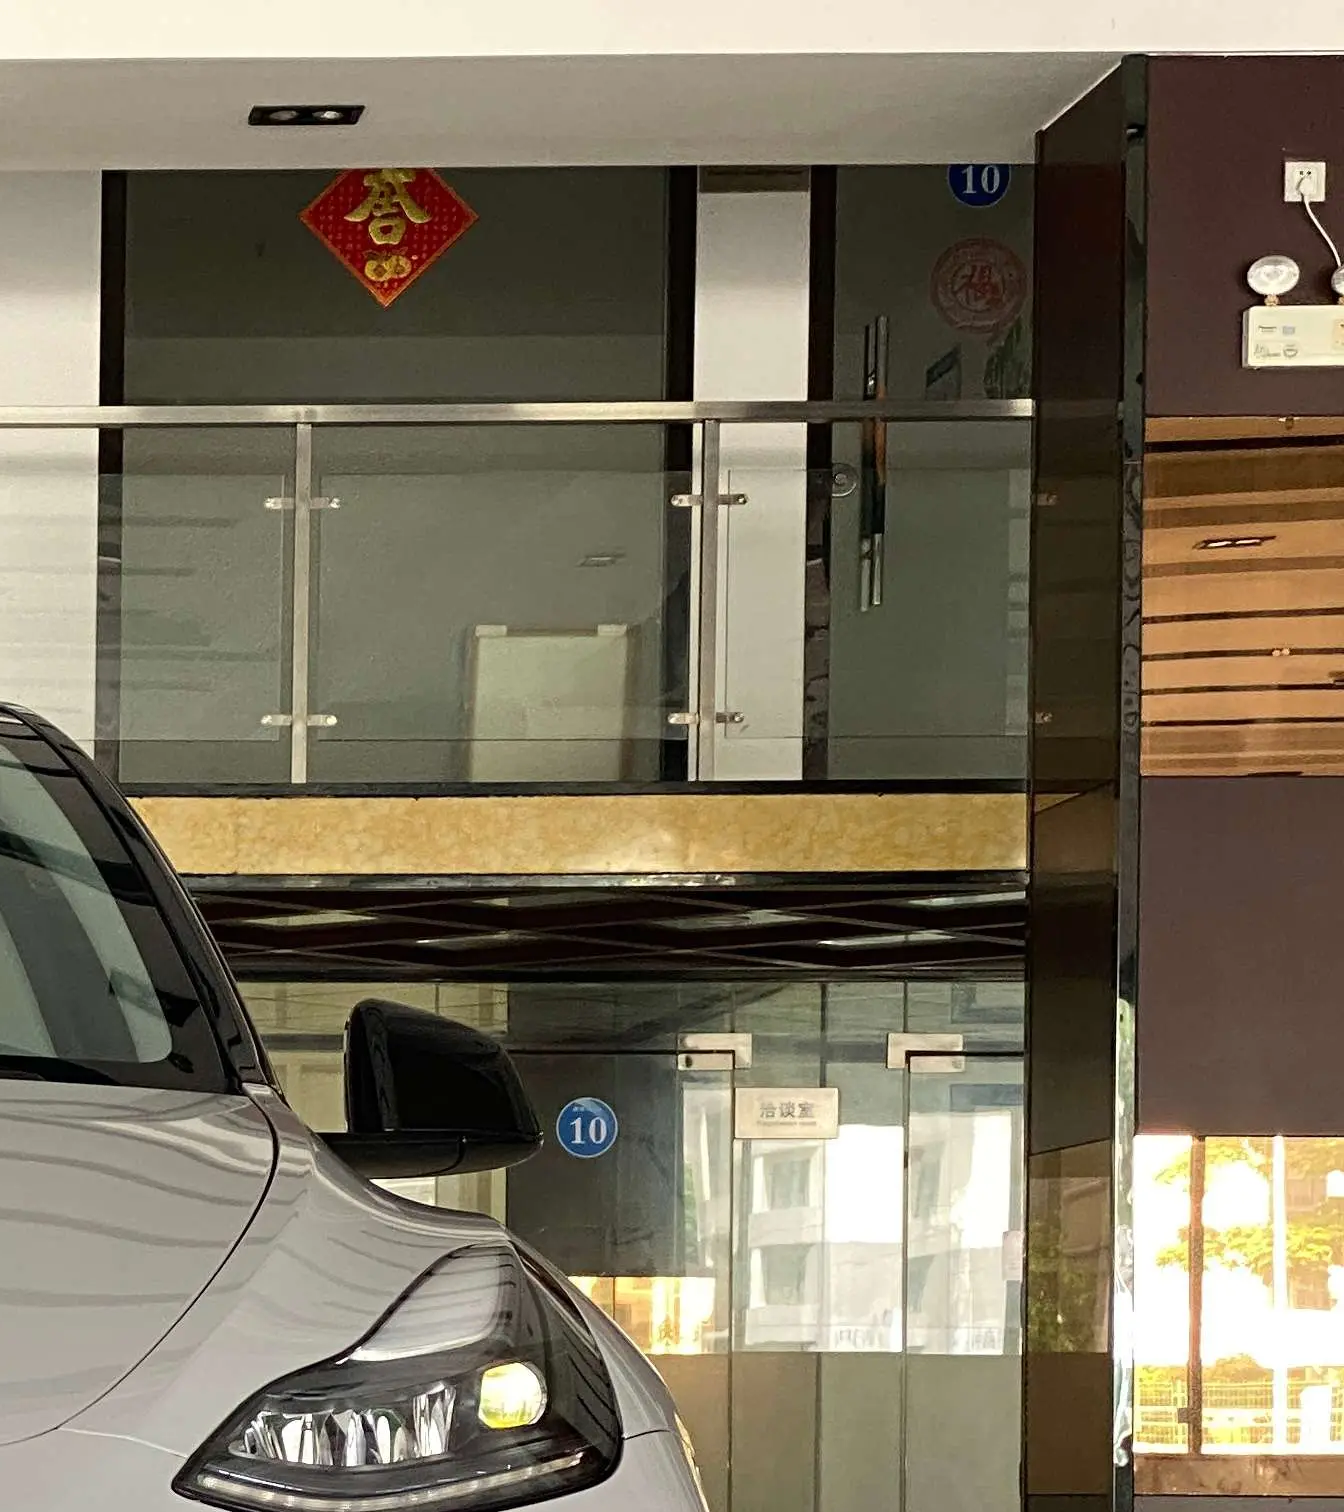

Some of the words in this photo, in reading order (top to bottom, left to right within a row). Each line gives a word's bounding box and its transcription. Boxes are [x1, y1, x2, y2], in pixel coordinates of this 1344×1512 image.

[962, 165, 1001, 194] 10
[760, 1101, 815, 1118] 洽谈室
[570, 1116, 607, 1144] 10
